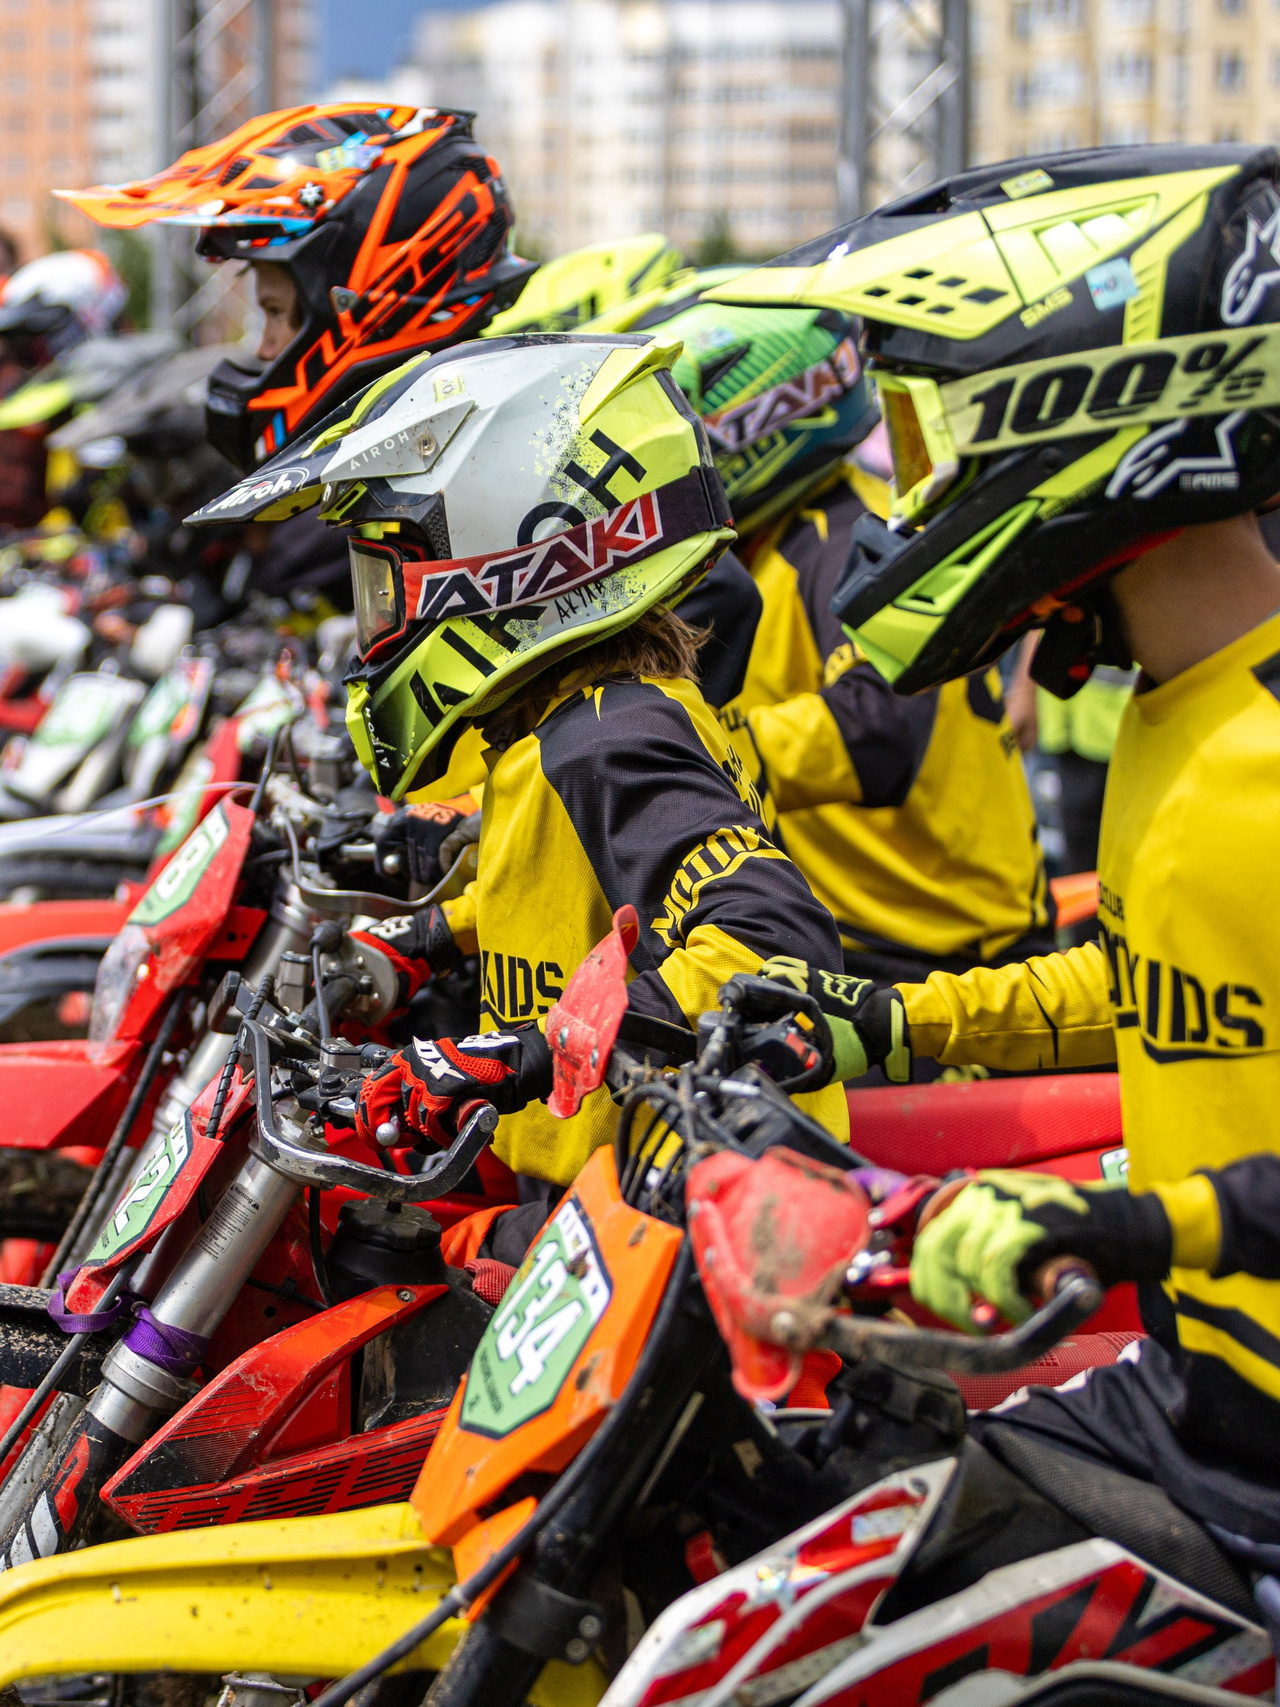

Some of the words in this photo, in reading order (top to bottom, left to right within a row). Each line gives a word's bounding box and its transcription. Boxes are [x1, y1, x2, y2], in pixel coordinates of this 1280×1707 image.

[970, 335, 1269, 444] 100%
[206, 473, 293, 514] Airoh
[349, 430, 411, 471] AIROH
[416, 490, 664, 619] ATAKI
[493, 1239, 585, 1397] 134
